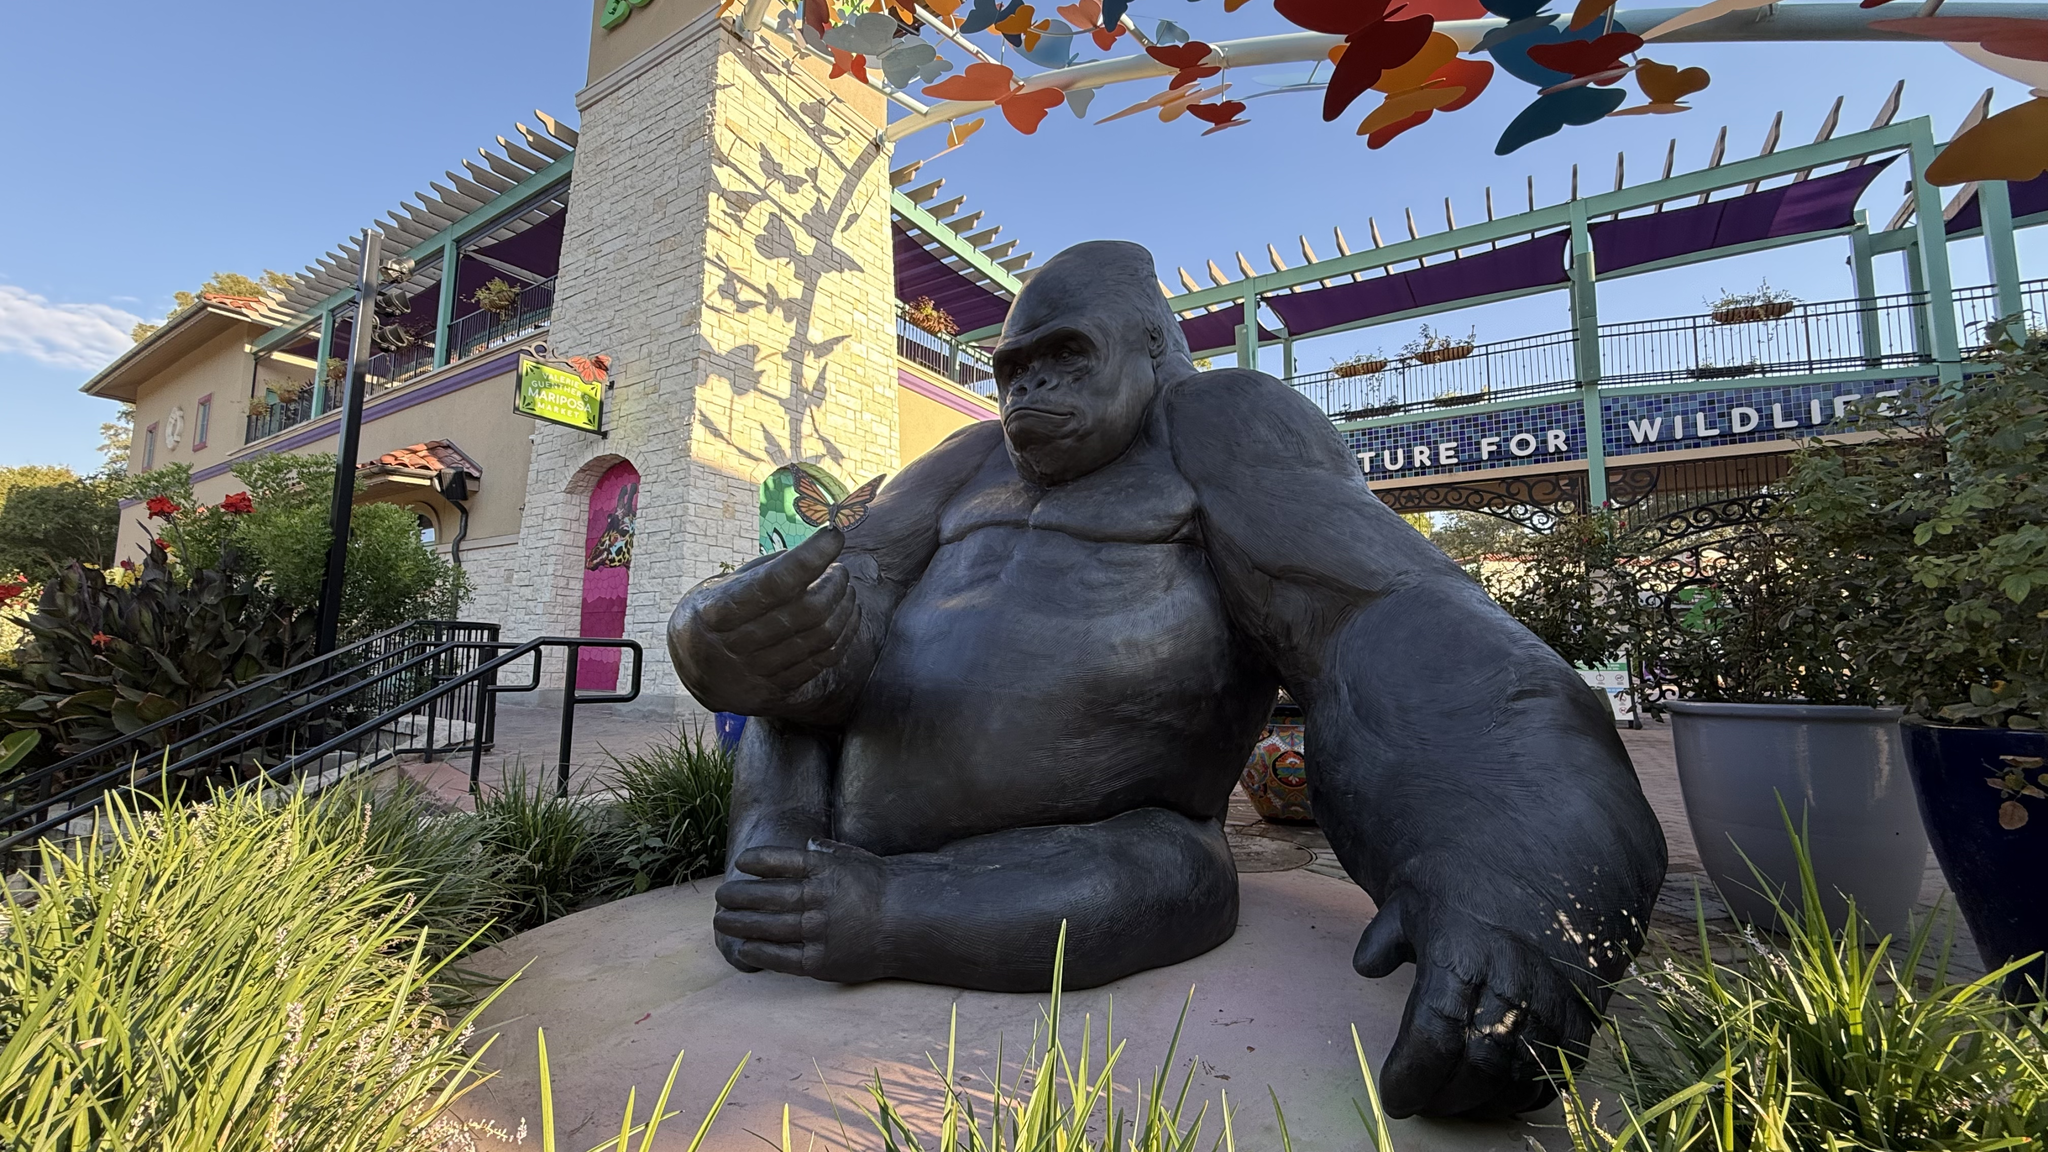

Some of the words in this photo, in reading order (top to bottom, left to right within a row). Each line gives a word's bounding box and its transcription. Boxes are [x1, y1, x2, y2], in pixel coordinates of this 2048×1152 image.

[531, 380, 590, 402] GUENTHER'S
[542, 372, 580, 389] VALERIE
[528, 387, 592, 413] MARIPOSA
[537, 402, 579, 418] MARKET
[1481, 429, 1568, 461] FOR
[1628, 389, 1908, 444] WILDLIFE
